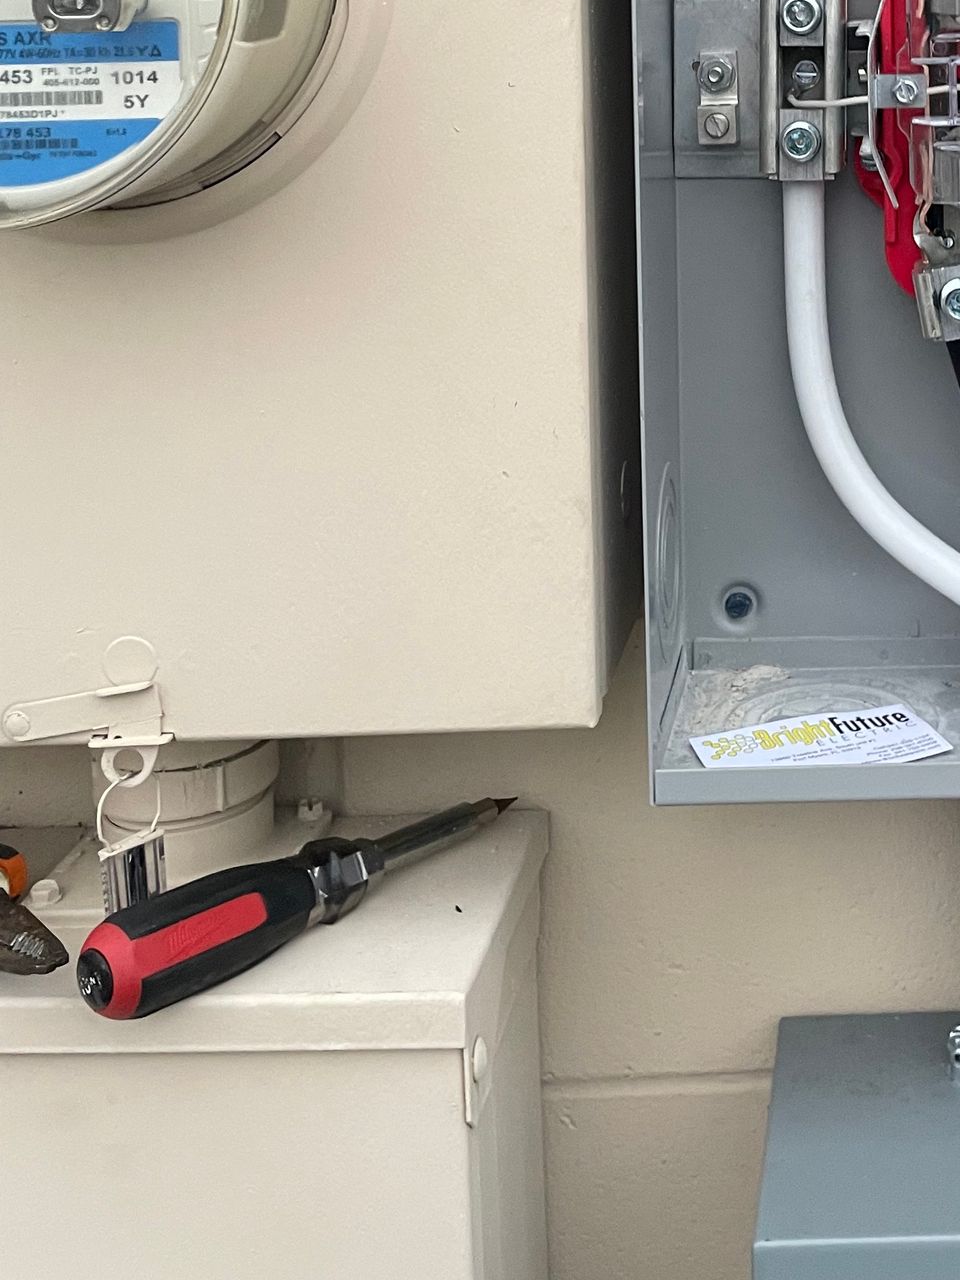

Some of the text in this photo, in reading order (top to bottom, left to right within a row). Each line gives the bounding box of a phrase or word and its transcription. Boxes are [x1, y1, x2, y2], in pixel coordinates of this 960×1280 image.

[0, 66, 159, 85] 453 FPL TC-PJ 1014
[123, 94, 150, 109] 5Y
[25, 126, 52, 139] 453
[815, 721, 917, 747] ELECTRIC
